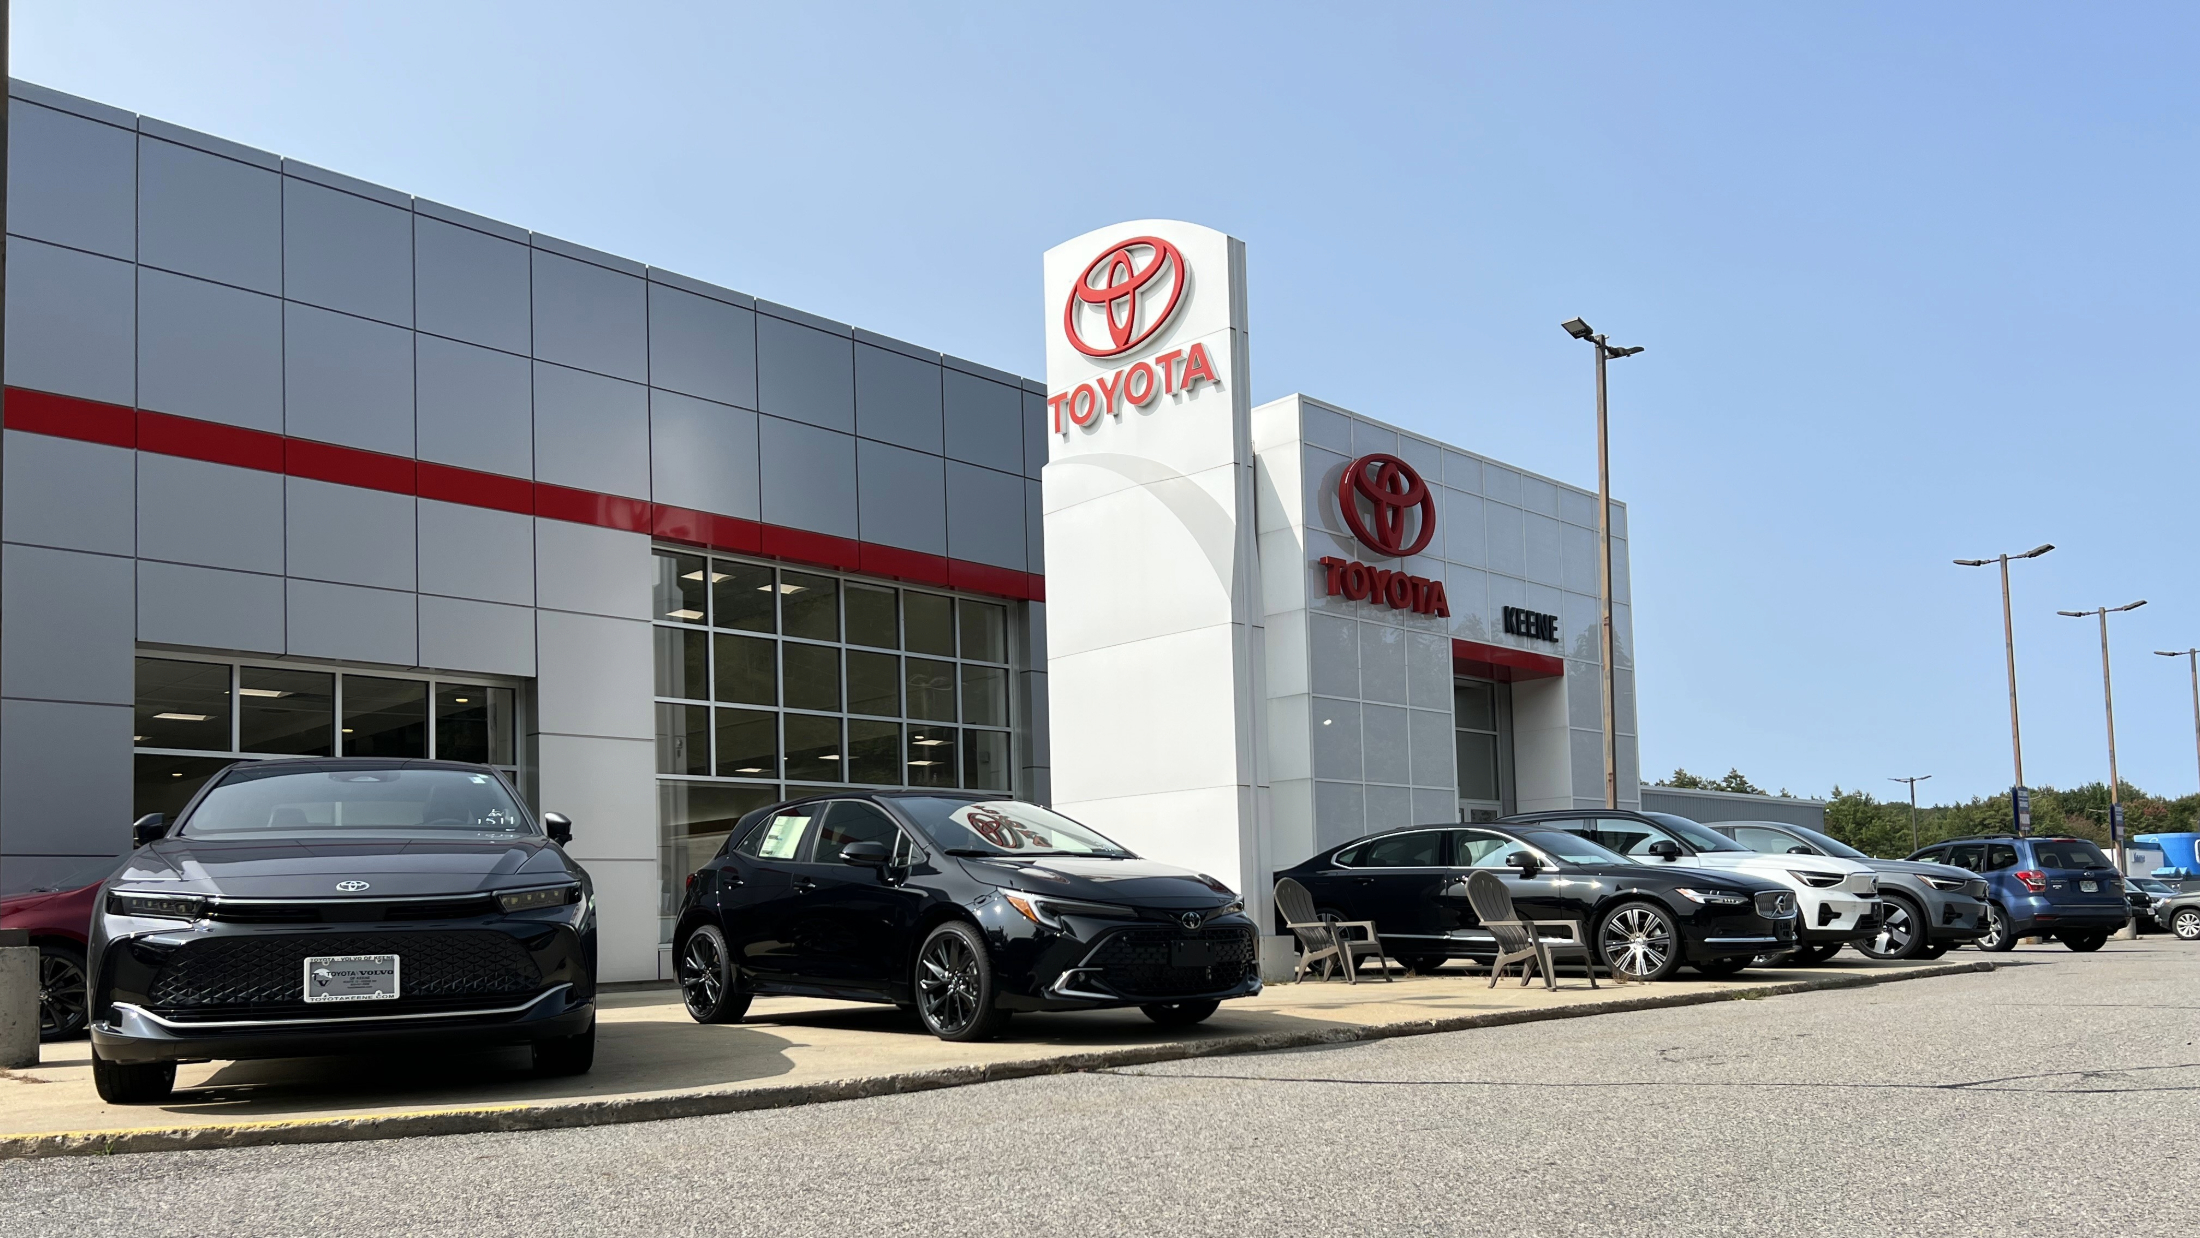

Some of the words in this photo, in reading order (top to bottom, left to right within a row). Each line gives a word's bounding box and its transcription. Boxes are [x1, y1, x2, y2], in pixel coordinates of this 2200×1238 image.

[1048, 342, 1220, 434] TOYOTA
[1320, 555, 1451, 618] TOYOTA
[1503, 605, 1559, 643] KEENE
